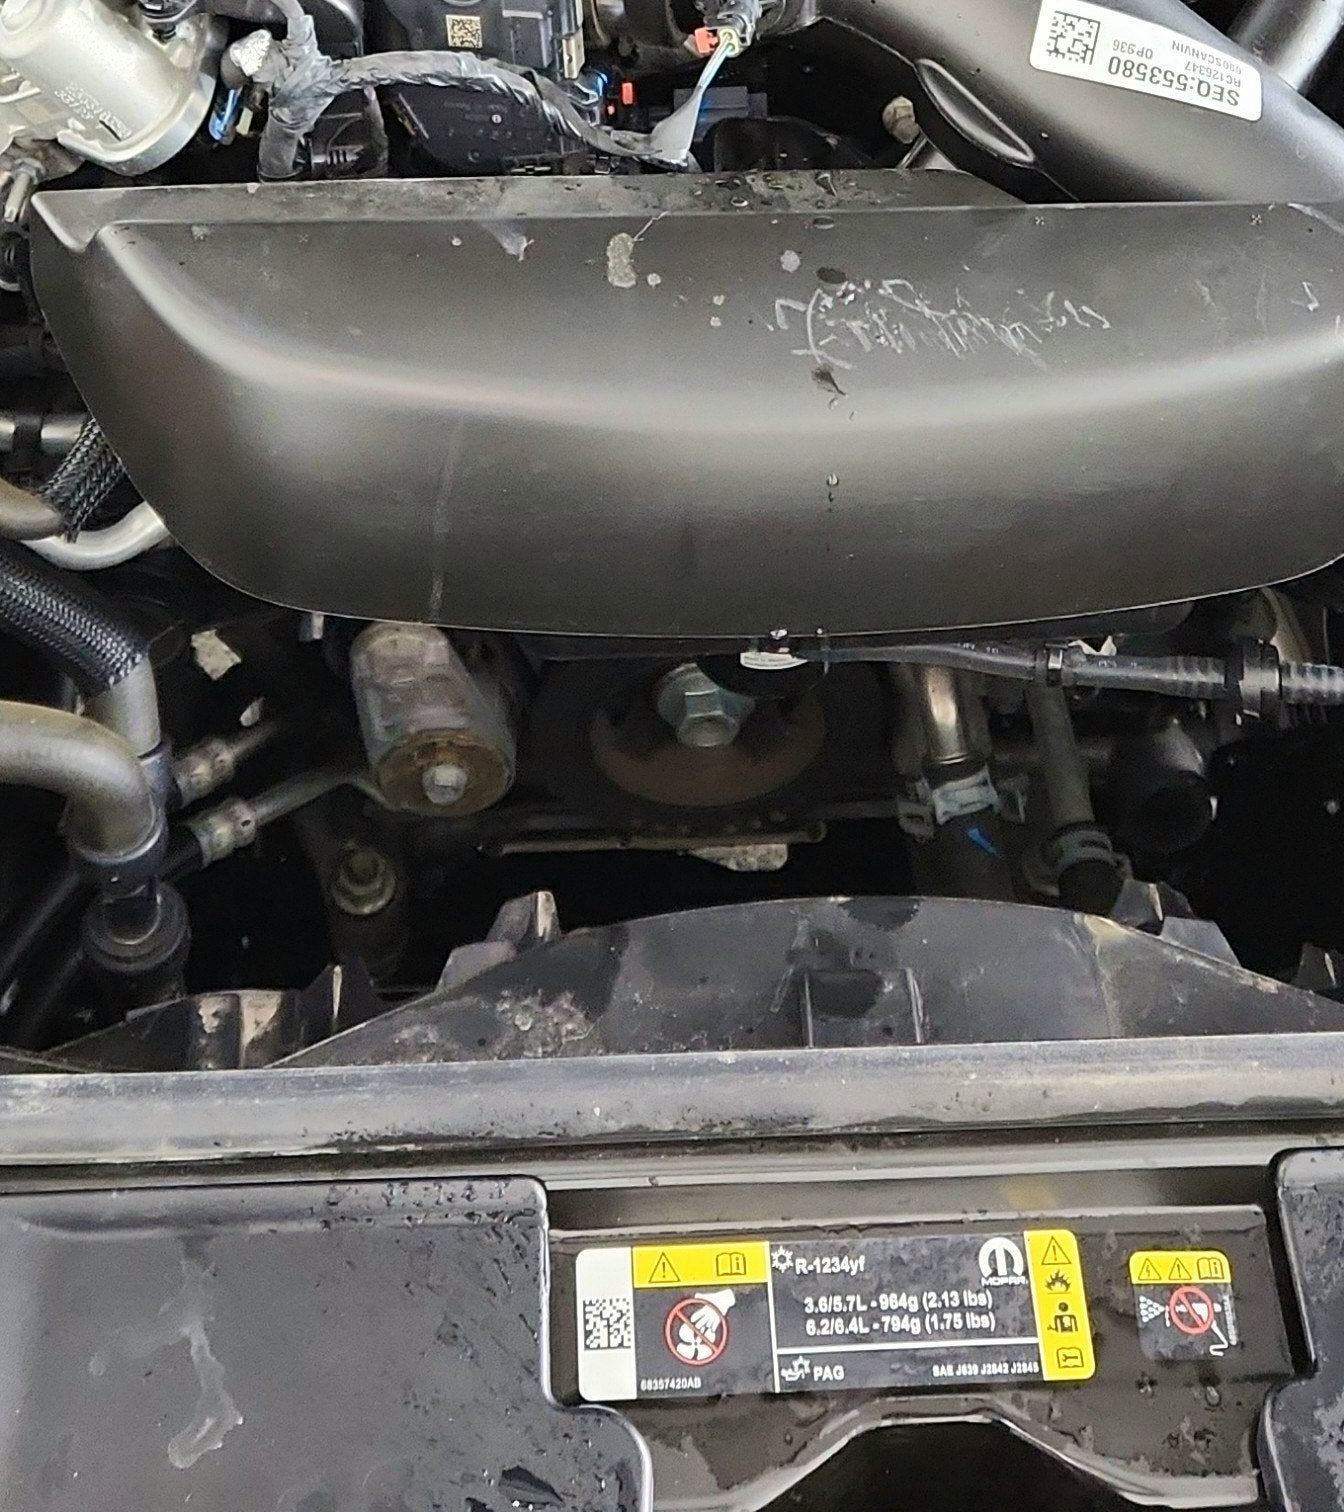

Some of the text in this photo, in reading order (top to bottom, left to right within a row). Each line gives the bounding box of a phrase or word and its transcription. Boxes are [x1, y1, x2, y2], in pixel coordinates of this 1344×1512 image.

[1107, 55, 1241, 107] SEQ:553580
[1184, 59, 1242, 88] RC126347
[795, 1255, 866, 1276] R-1234yf
[804, 1294, 867, 1314] 3.6/5.7L
[878, 1292, 919, 1313] 964g
[922, 1291, 960, 1312] (2.13
[963, 1289, 993, 1309] lbs)
[805, 1316, 870, 1336] 6.2/6.4L
[881, 1314, 921, 1335] 794g
[925, 1313, 963, 1334] (1.75
[965, 1311, 996, 1332] lbs)
[813, 1365, 845, 1381] PAG
[932, 1364, 954, 1377] SAE
[955, 1363, 978, 1377] J639
